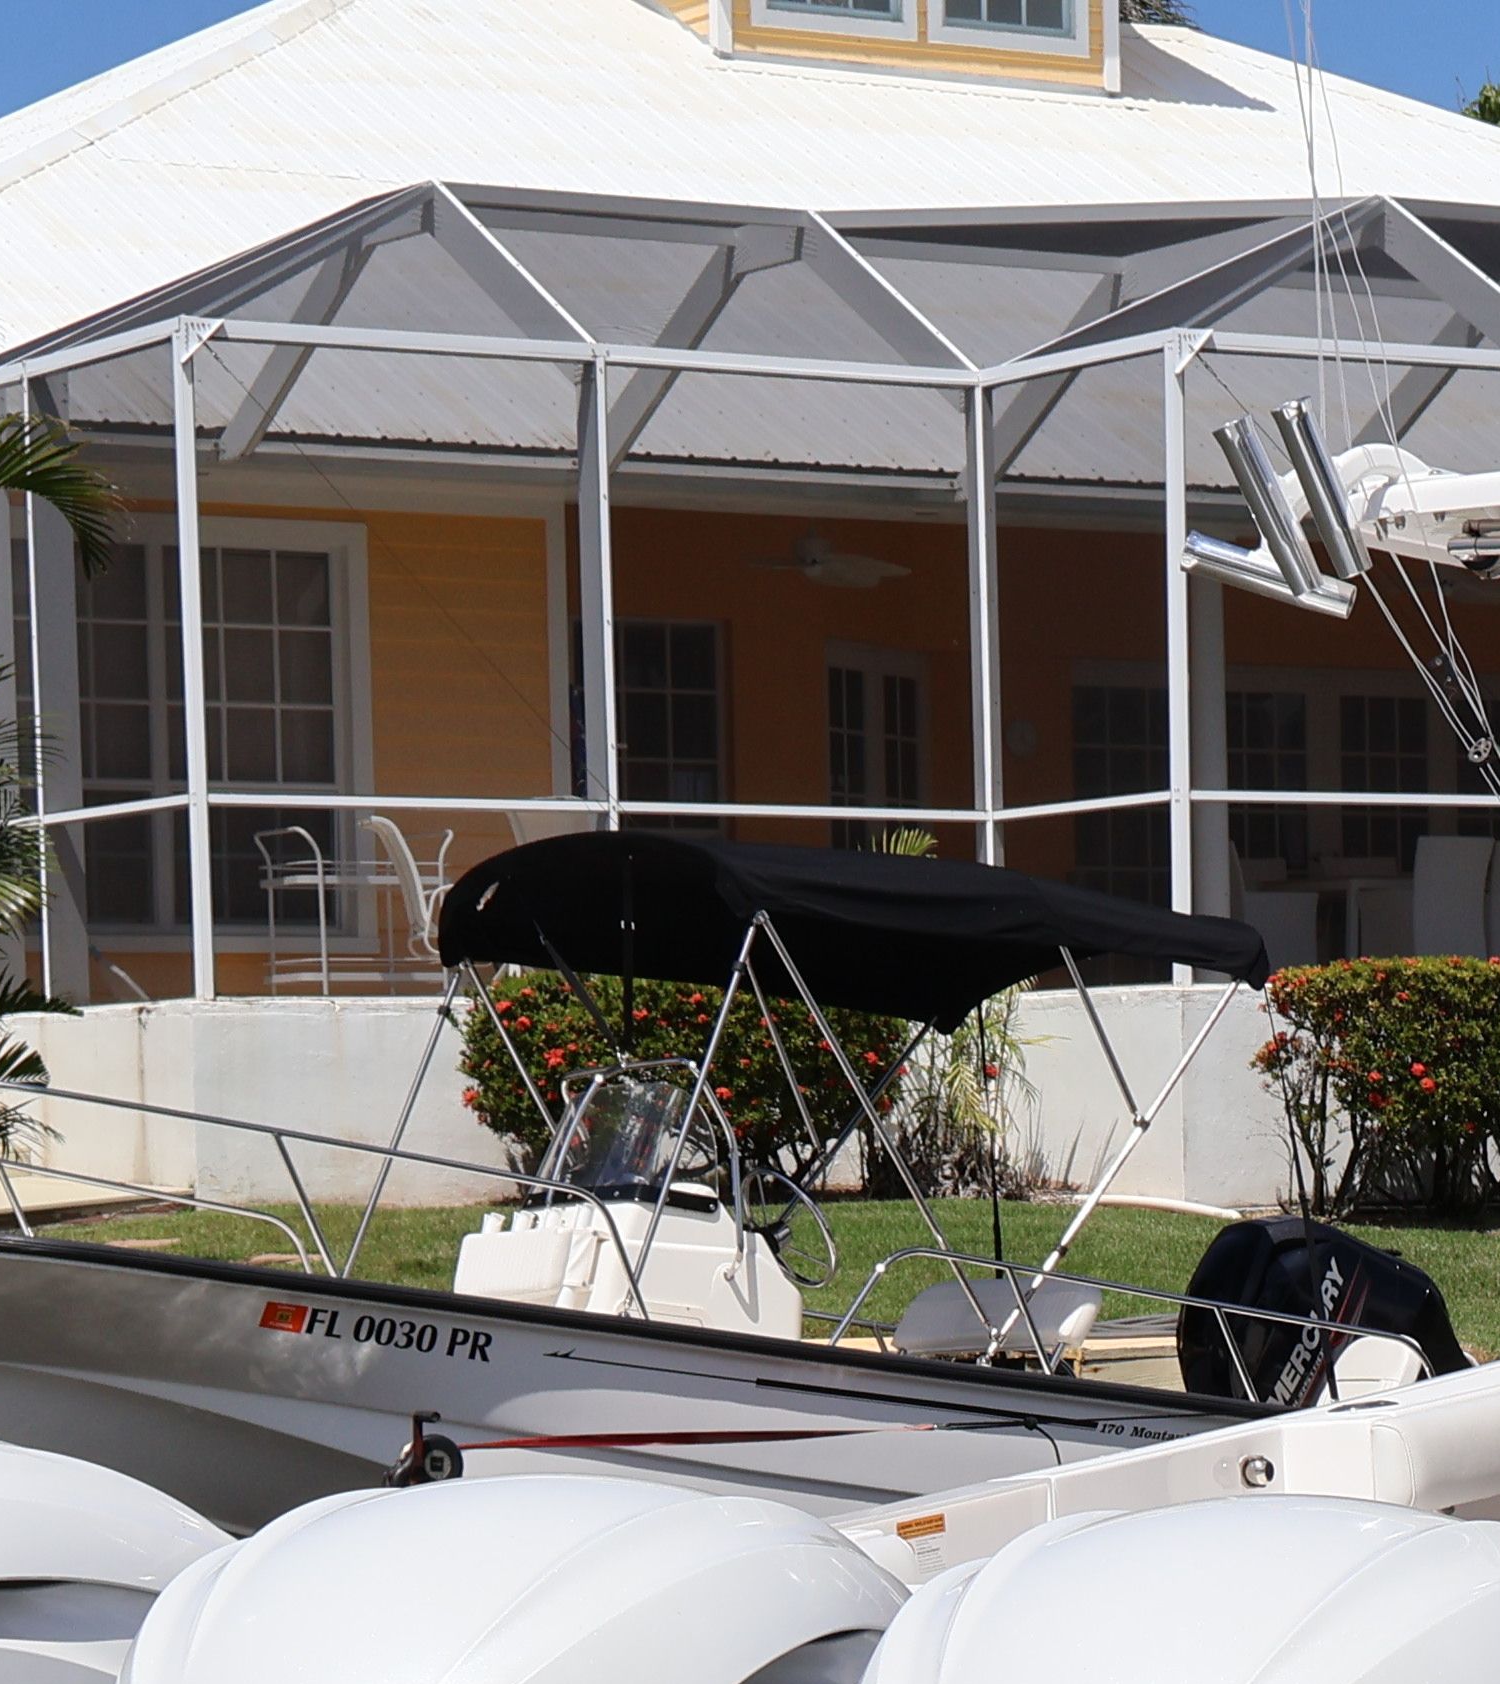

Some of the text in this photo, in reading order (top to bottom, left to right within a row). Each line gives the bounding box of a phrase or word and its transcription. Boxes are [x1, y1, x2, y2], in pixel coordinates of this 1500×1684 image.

[304, 1308, 493, 1362] FL 0030 PR
[1266, 1256, 1344, 1407] MERCRY
[1100, 1423, 1125, 1436] 170
